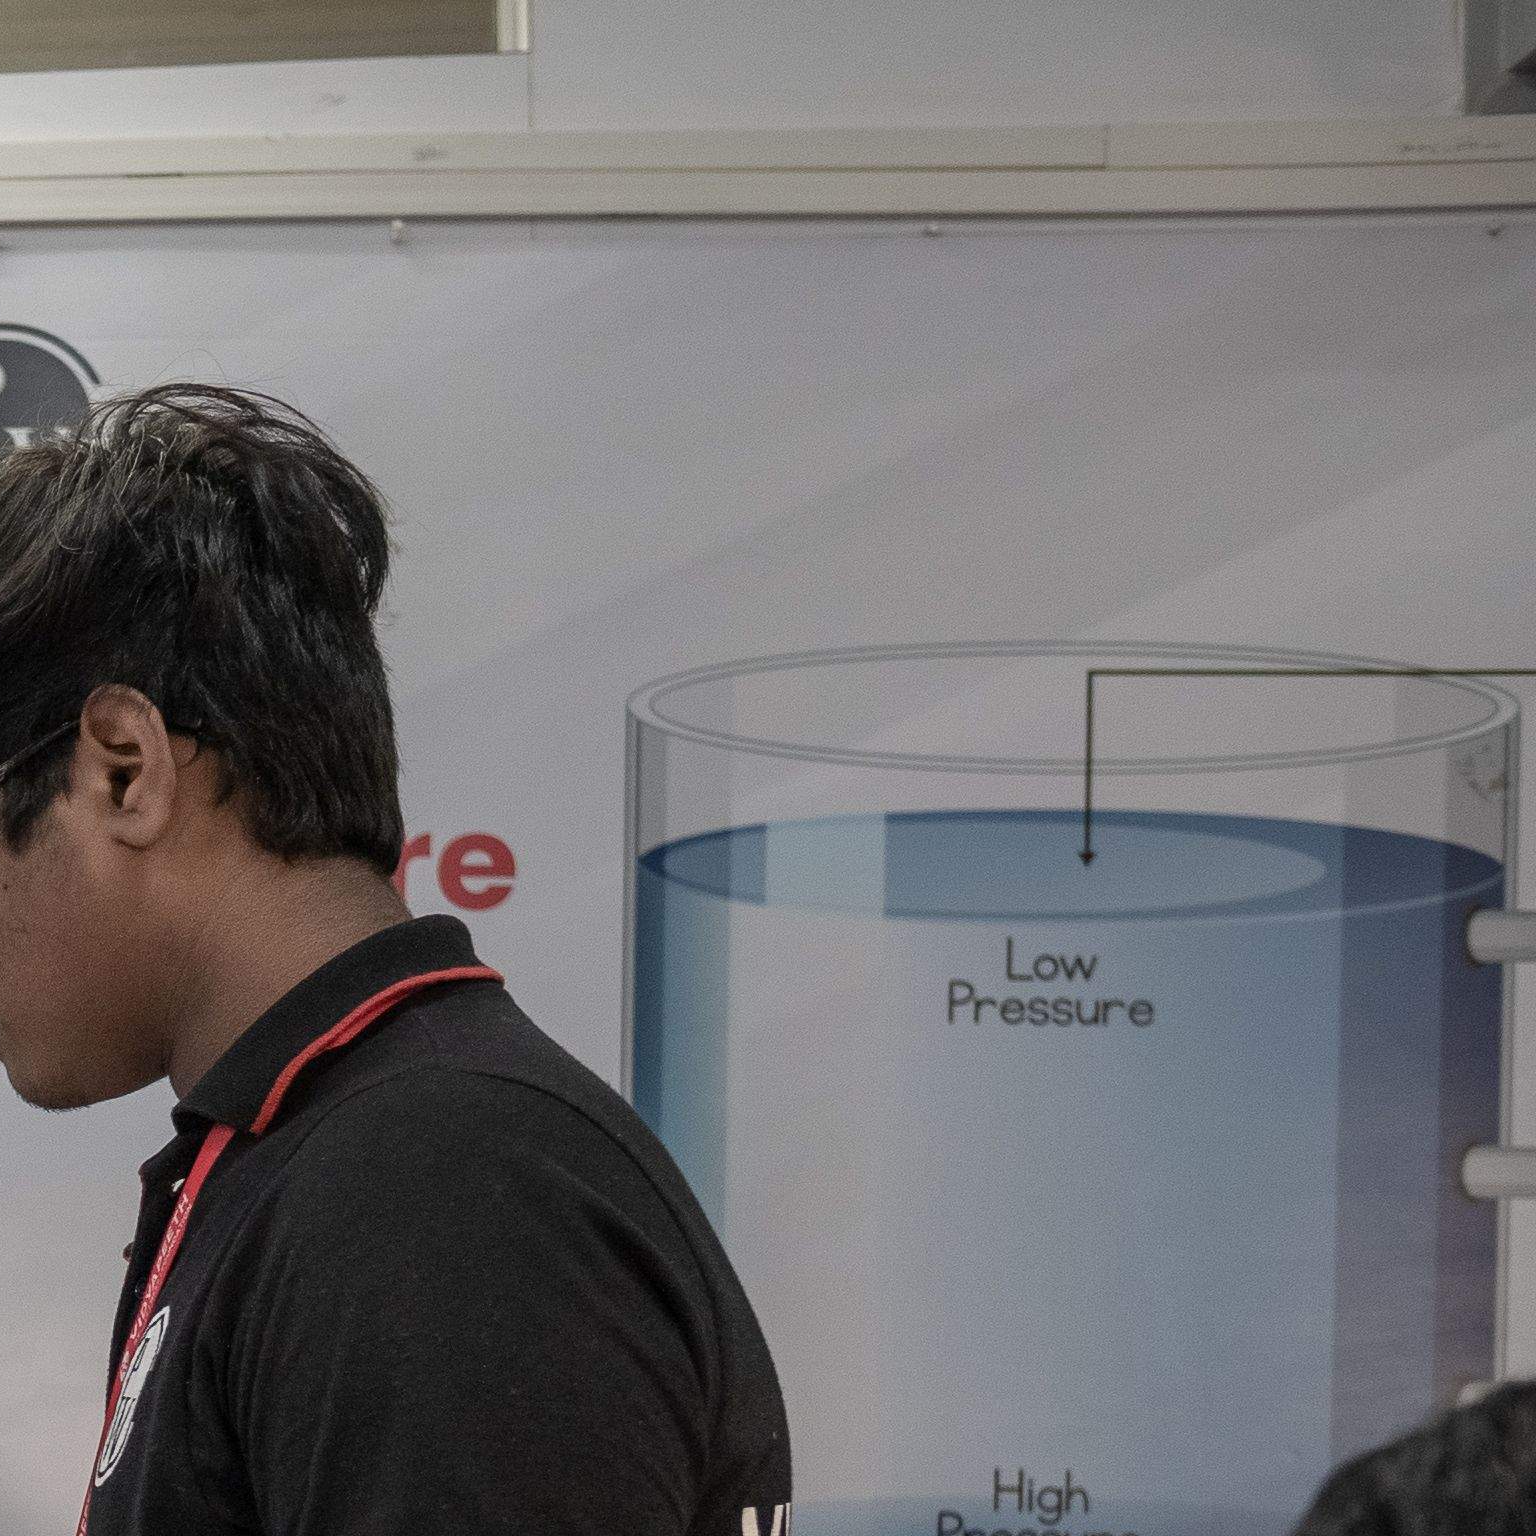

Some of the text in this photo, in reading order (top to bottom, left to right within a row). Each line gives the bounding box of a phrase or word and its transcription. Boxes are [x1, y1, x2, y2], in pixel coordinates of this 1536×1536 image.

[1005, 937, 1097, 982] Low
[946, 984, 1156, 1029] Pressure
[129, 1192, 190, 1341] VIDYAPEETH
[991, 1468, 1090, 1523] High
